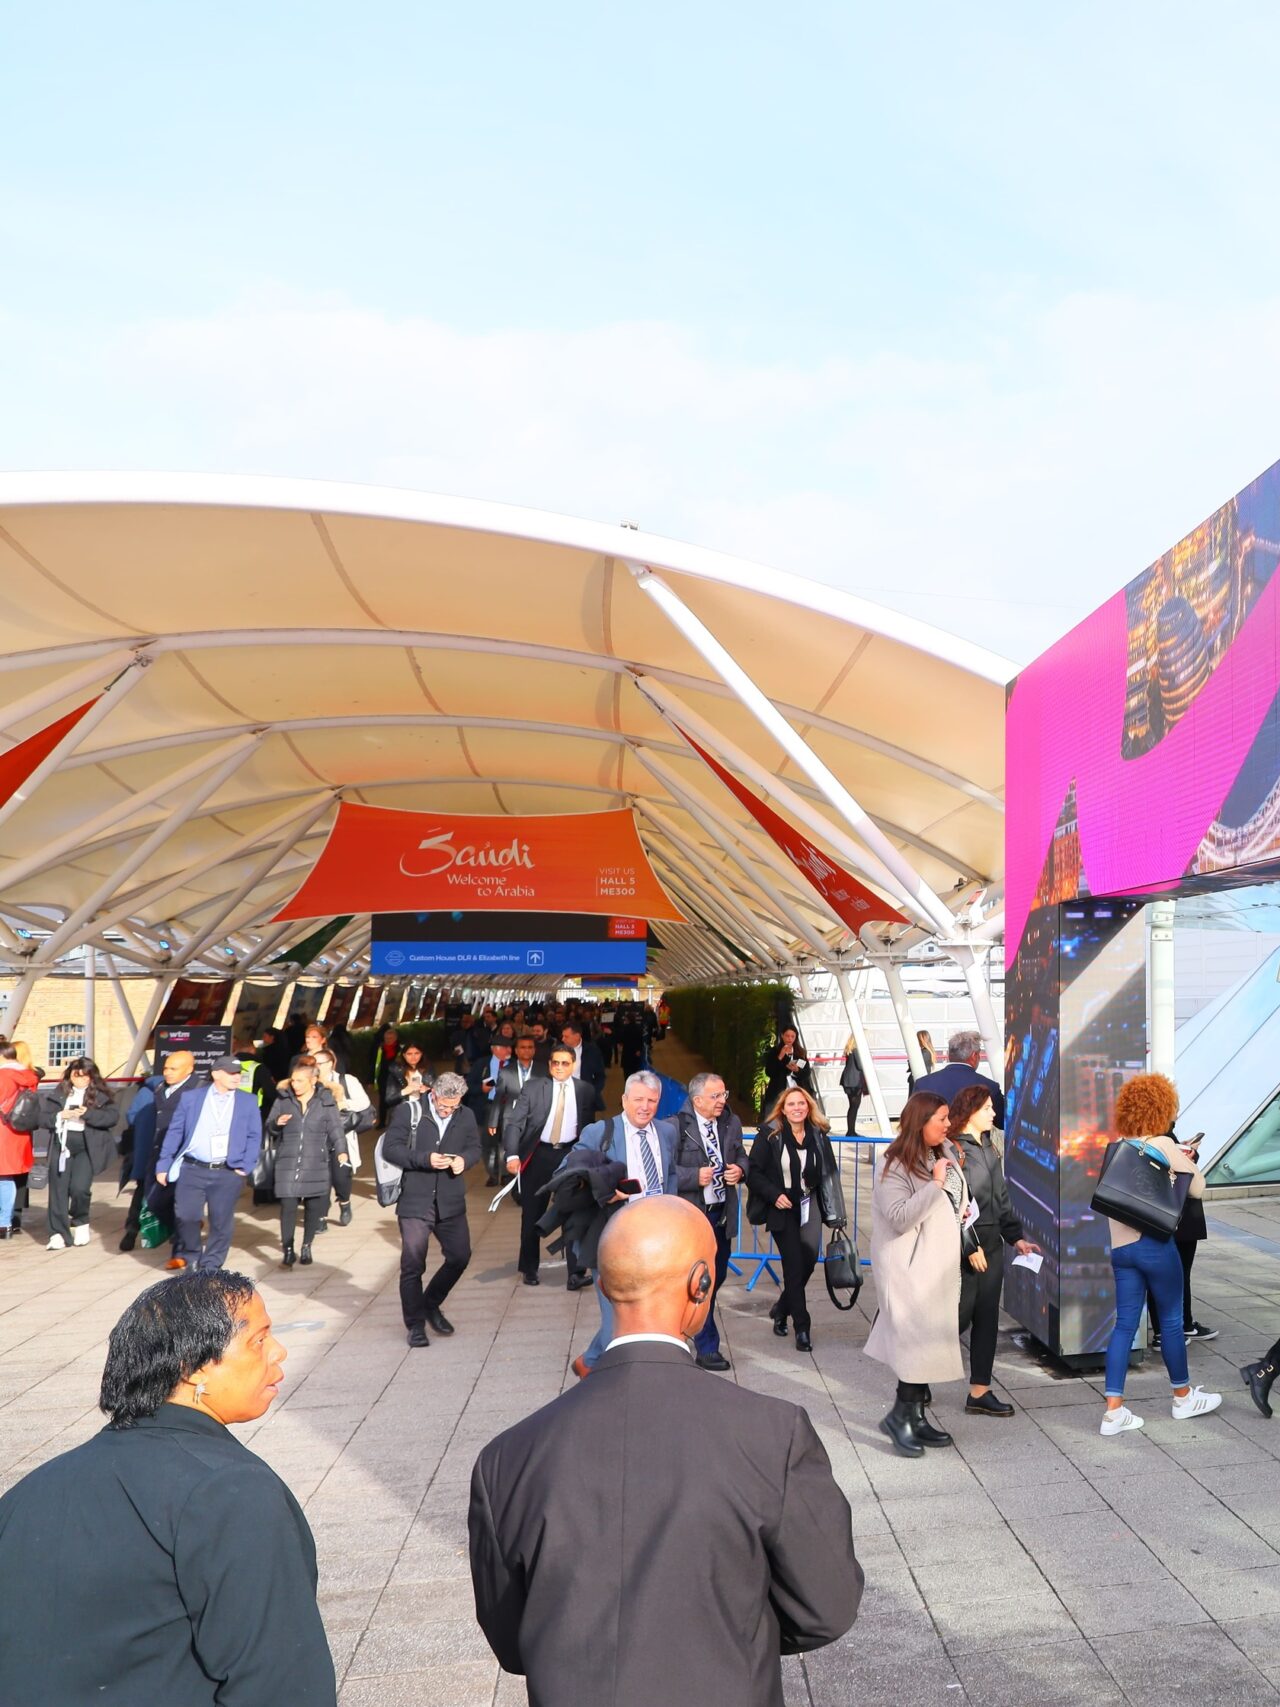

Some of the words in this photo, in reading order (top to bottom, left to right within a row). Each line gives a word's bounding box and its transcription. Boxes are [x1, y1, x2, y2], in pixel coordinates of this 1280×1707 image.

[400, 829, 535, 877] Saudi
[446, 873, 507, 885] Welcome
[600, 877, 626, 885] HALL
[629, 877, 635, 885] 5
[477, 886, 491, 896] to
[494, 885, 535, 896] Arabia
[600, 887, 635, 895] ME300
